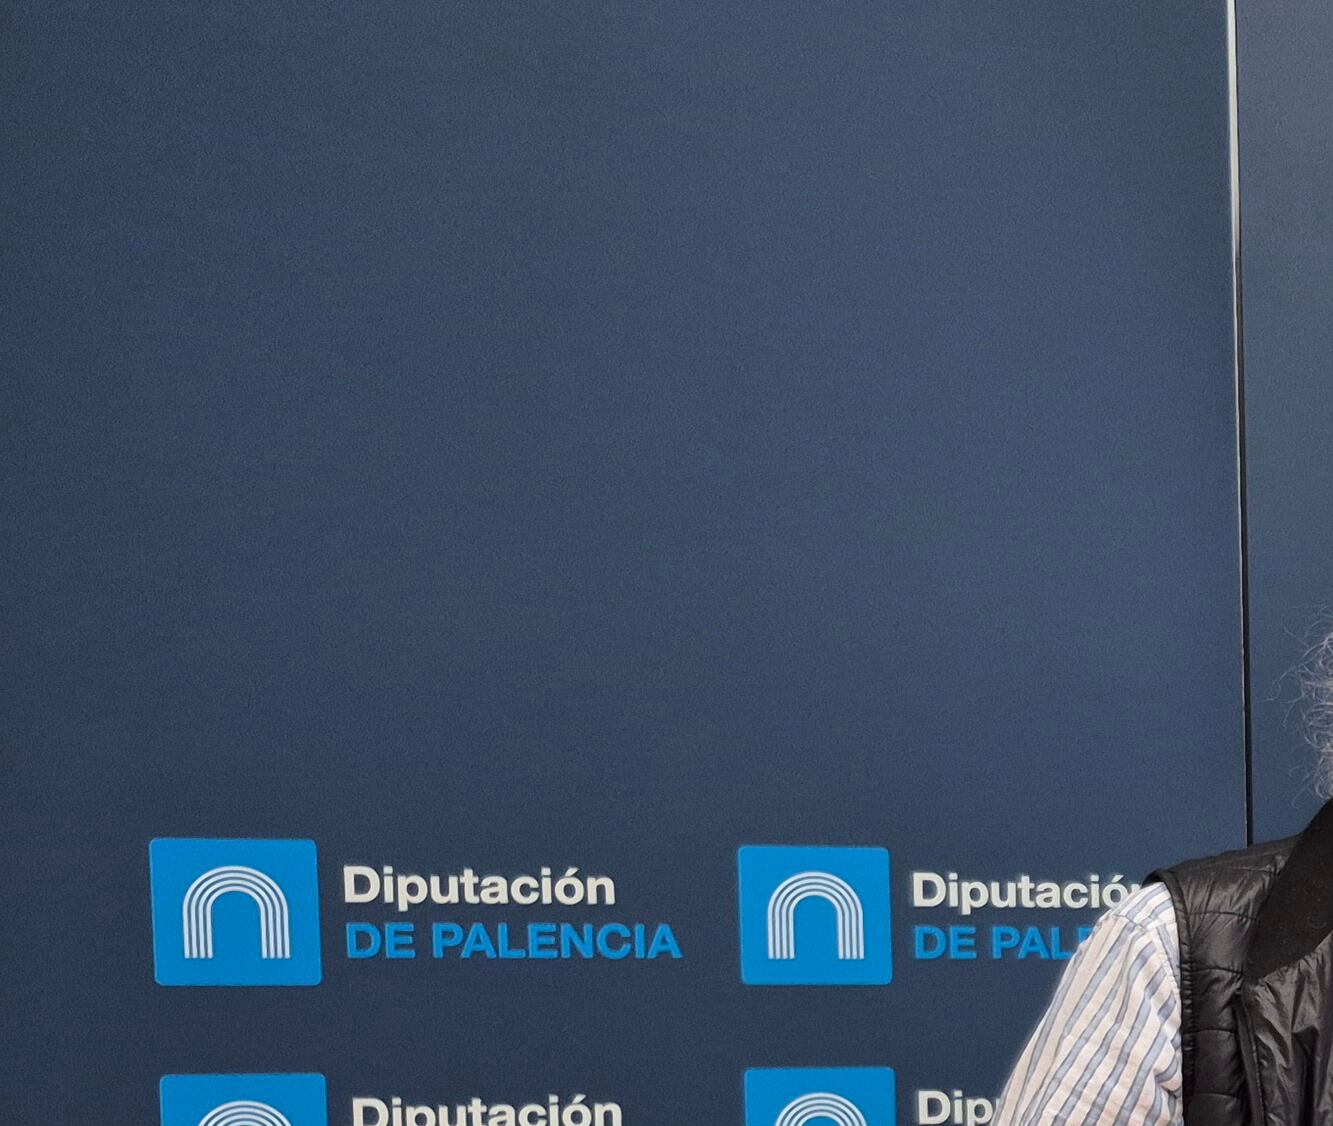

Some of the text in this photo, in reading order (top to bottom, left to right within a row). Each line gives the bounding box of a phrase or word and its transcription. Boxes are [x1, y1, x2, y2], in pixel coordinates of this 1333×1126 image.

[343, 865, 617, 911] Diputación
[346, 922, 683, 960] DE PALENCIA
[914, 925, 978, 960] DE
